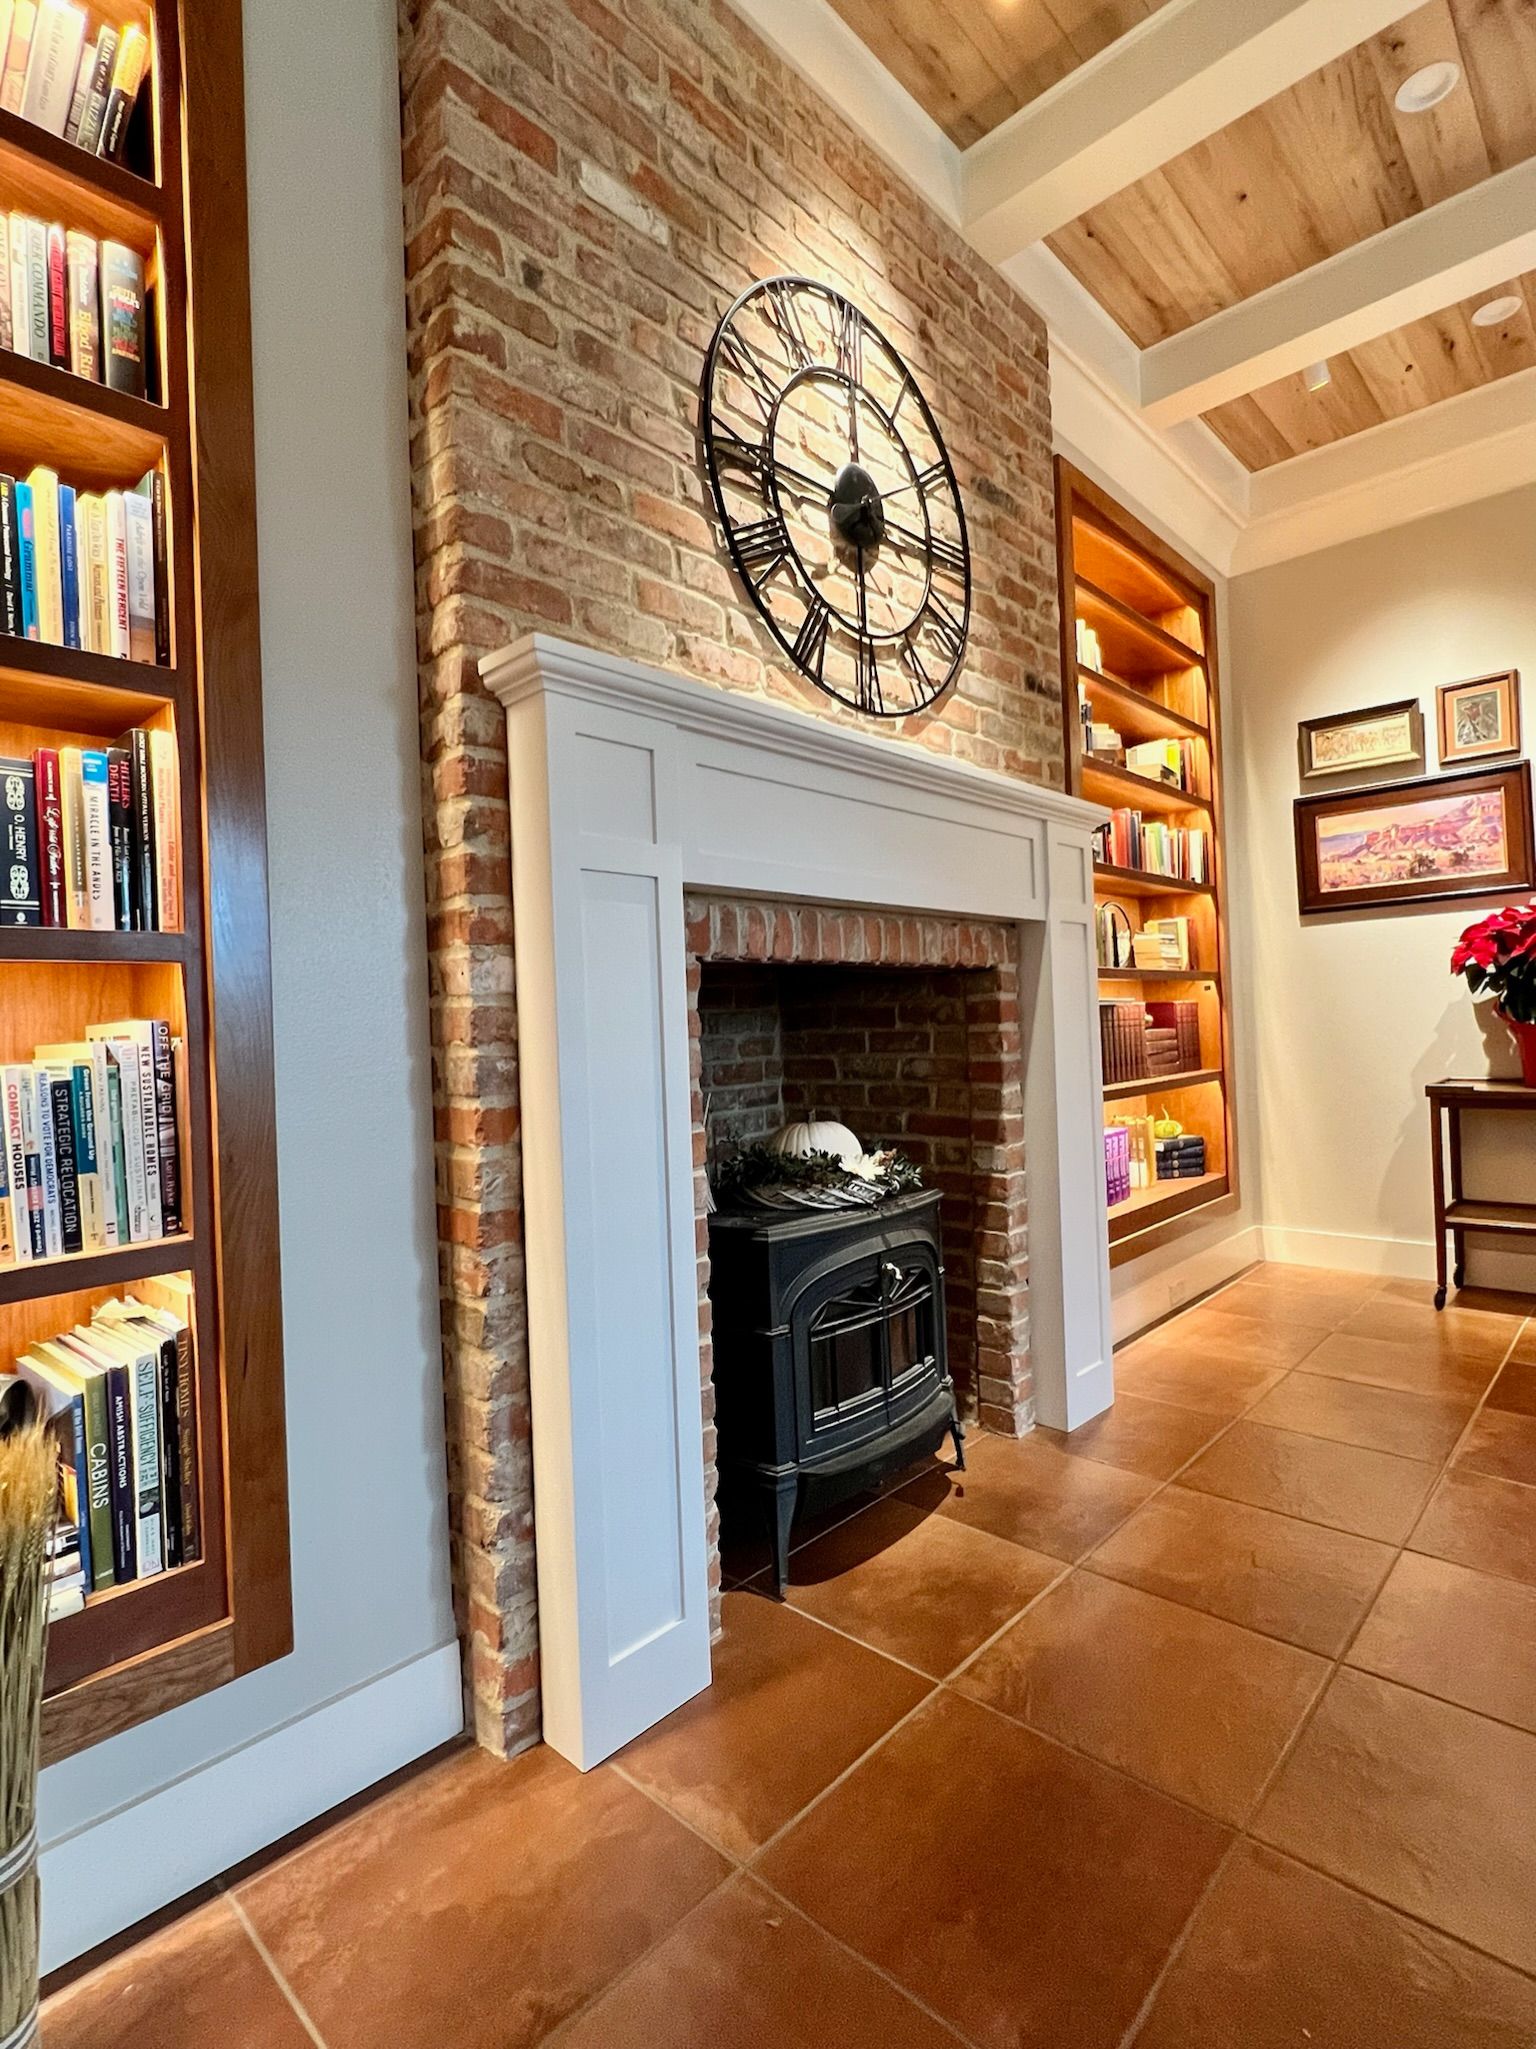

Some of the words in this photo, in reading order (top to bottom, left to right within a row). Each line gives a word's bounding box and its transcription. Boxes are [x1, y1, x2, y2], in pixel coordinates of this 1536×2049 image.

[101, 38, 116, 64] MARK
[33, 262, 46, 339] COMMANDO
[78, 309, 93, 348] Blood
[80, 352, 93, 379] Riv
[115, 538, 125, 554] THE
[4, 557, 12, 581] Theology
[23, 541, 35, 593] Grammar
[116, 555, 126, 590] FIFTEEN
[135, 571, 148, 592] Open
[117, 592, 127, 631] PERCENT
[138, 732, 146, 749] HOLY
[109, 764, 120, 803] DEATH
[140, 765, 148, 792] MODERN
[14, 814, 23, 824] O.
[89, 796, 101, 834] MIRACLE
[142, 816, 150, 841] VERSION
[14, 827, 26, 861] HENRY
[91, 837, 102, 847] IN
[112, 826, 121, 836] from
[47, 844, 61, 876] Father
[91, 851, 102, 867] THE
[92, 871, 104, 901] ANDES
[158, 1026, 169, 1050] OFF
[140, 1046, 151, 1067] NEW
[160, 1054, 170, 1078] THE
[39, 1073, 50, 1108] REASONS
[82, 1069, 91, 1091] Green
[7, 1084, 20, 1140] COMPACT
[83, 1092, 92, 1109] from
[110, 1102, 118, 1121] green
[142, 1072, 155, 1139] SUSTAINABLE
[161, 1084, 172, 1114] GRID
[42, 1110, 51, 1120] TO
[55, 1089, 72, 1155] STRATEGIC
[131, 1081, 140, 1147] PREFABULOUS
[42, 1122, 52, 1140] VOTE
[85, 1122, 93, 1150] Ground
[44, 1142, 53, 1157] FOR
[86, 1151, 94, 1160] Up
[145, 1144, 157, 1177] HOMES
[12, 1143, 25, 1190] HOUSES
[165, 1159, 174, 1181] Lori
[45, 1158, 56, 1204] DEMOCRATS
[165, 1182, 175, 1207] Ryker
[60, 1158, 77, 1233] RELOCATION
[33, 1228, 43, 1254] Toward
[178, 1338, 189, 1371] TINY
[180, 1372, 191, 1418] HOMES
[115, 1396, 125, 1423] AMISH
[137, 1361, 154, 1467] SELF-SUFFICIENCY
[182, 1429, 191, 1455] Simple
[116, 1425, 127, 1488] ABSTRACTIONS
[90, 1443, 109, 1509] CABINS
[183, 1457, 192, 1486] Shelter
